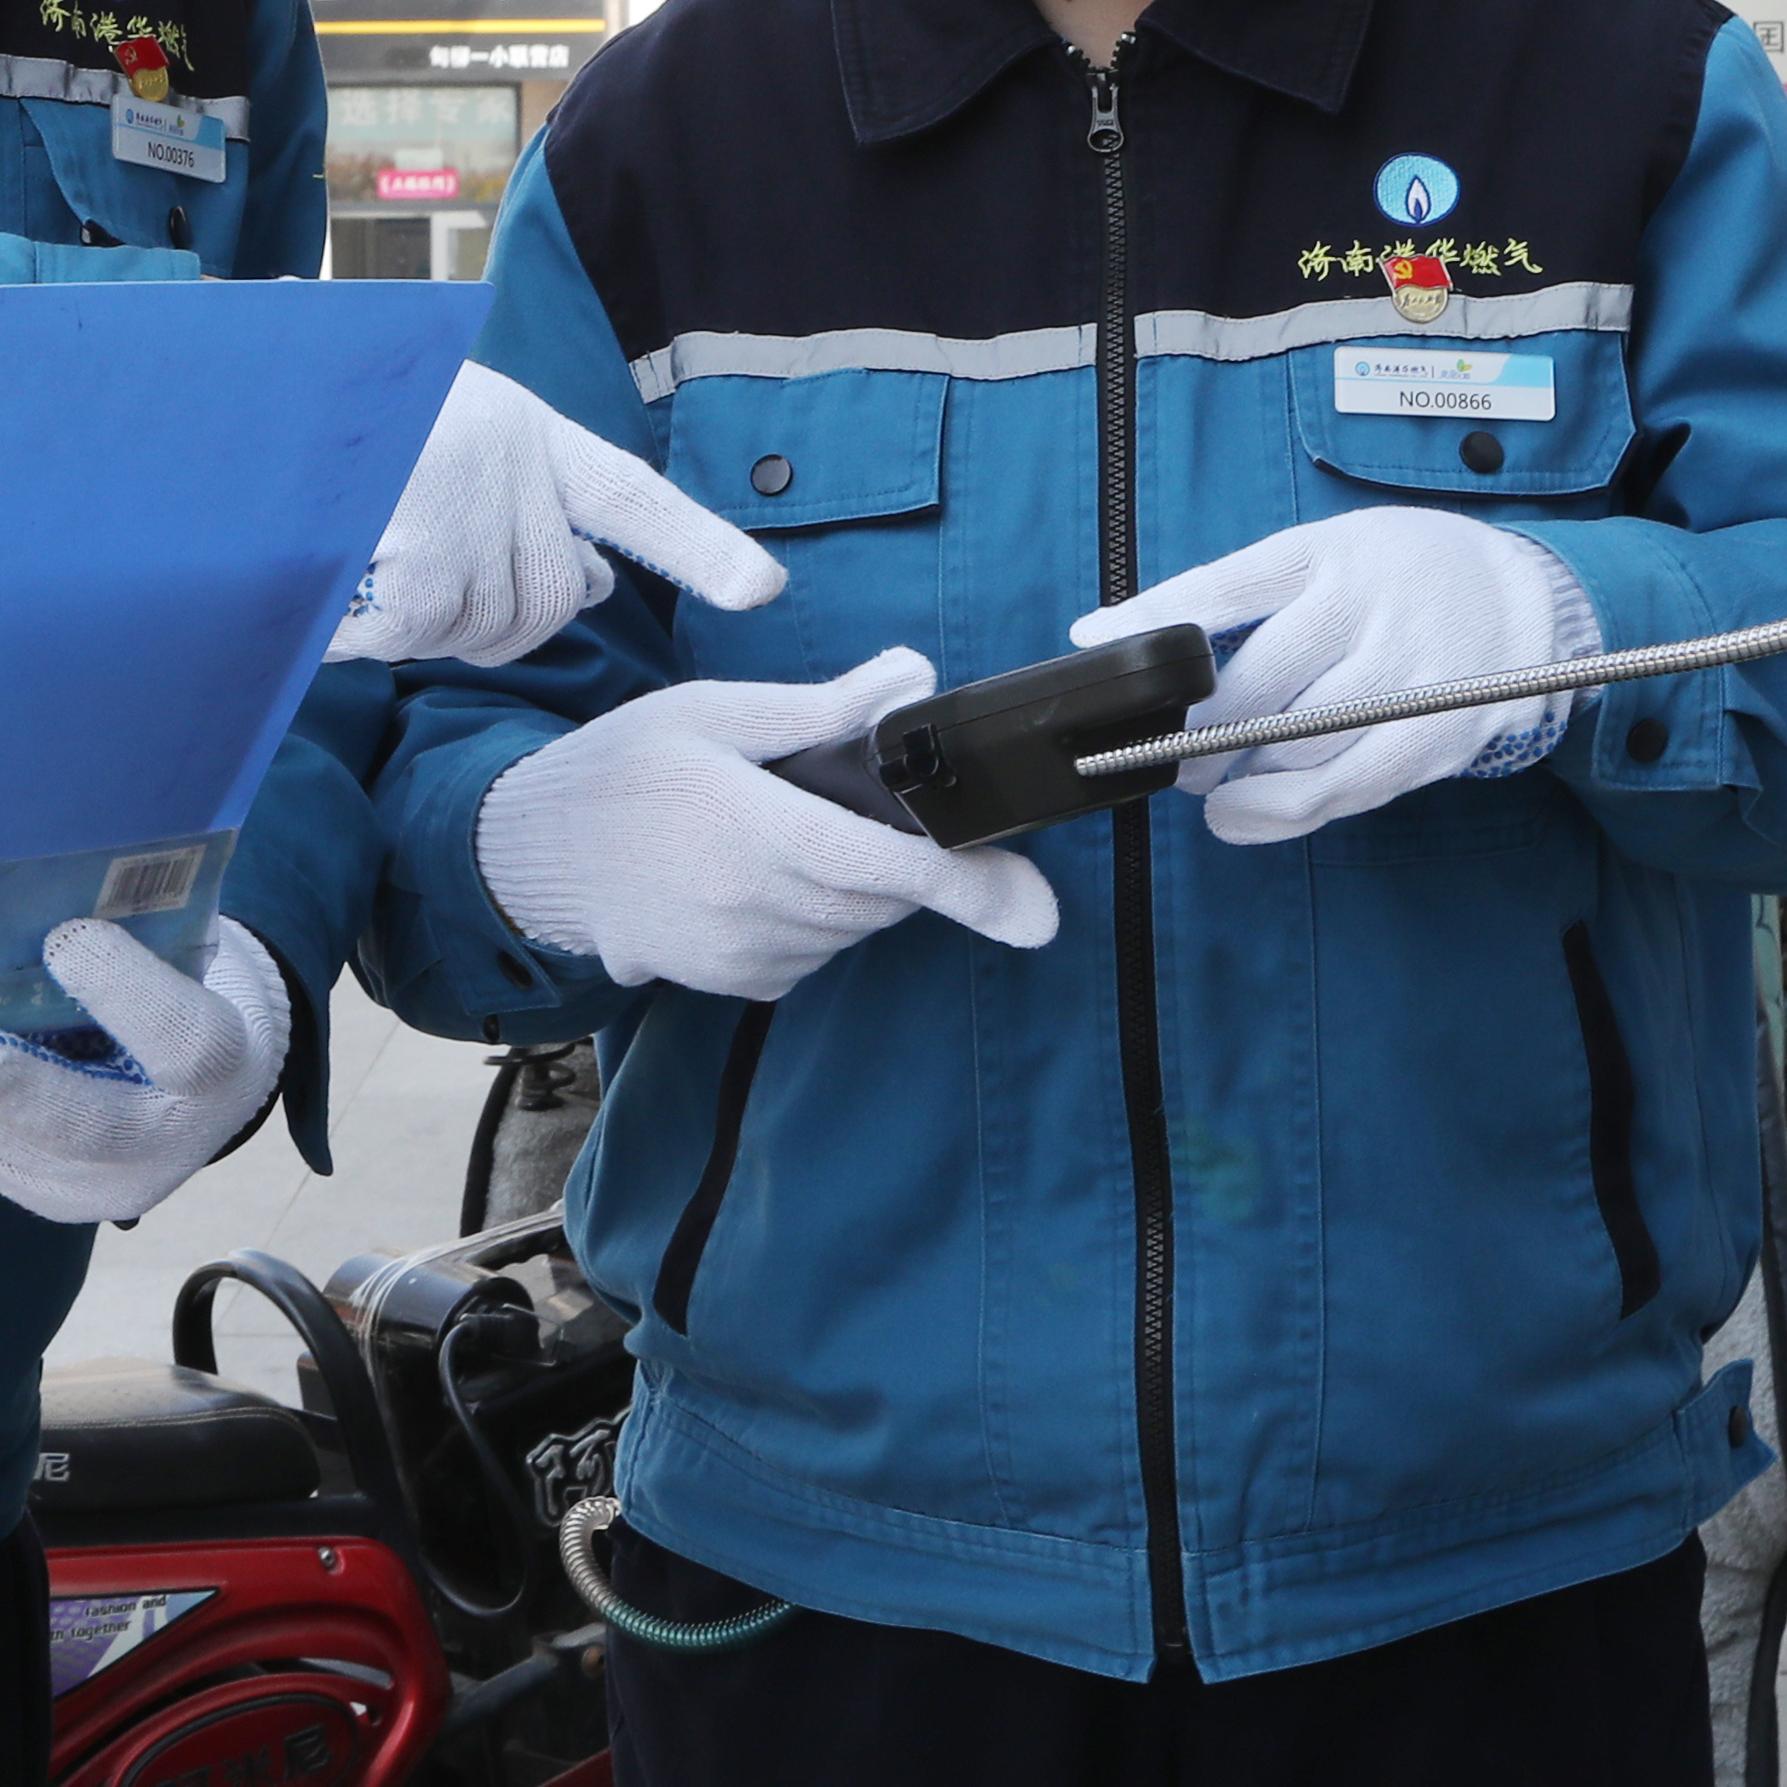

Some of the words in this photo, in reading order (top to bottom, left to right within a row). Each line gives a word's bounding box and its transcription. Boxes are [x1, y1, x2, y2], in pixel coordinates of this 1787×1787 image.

[147, 141, 195, 168] NO.00376
[1399, 391, 1492, 411] NO.00866
[142, 1594, 167, 1610] and
[70, 1620, 132, 1641] together
